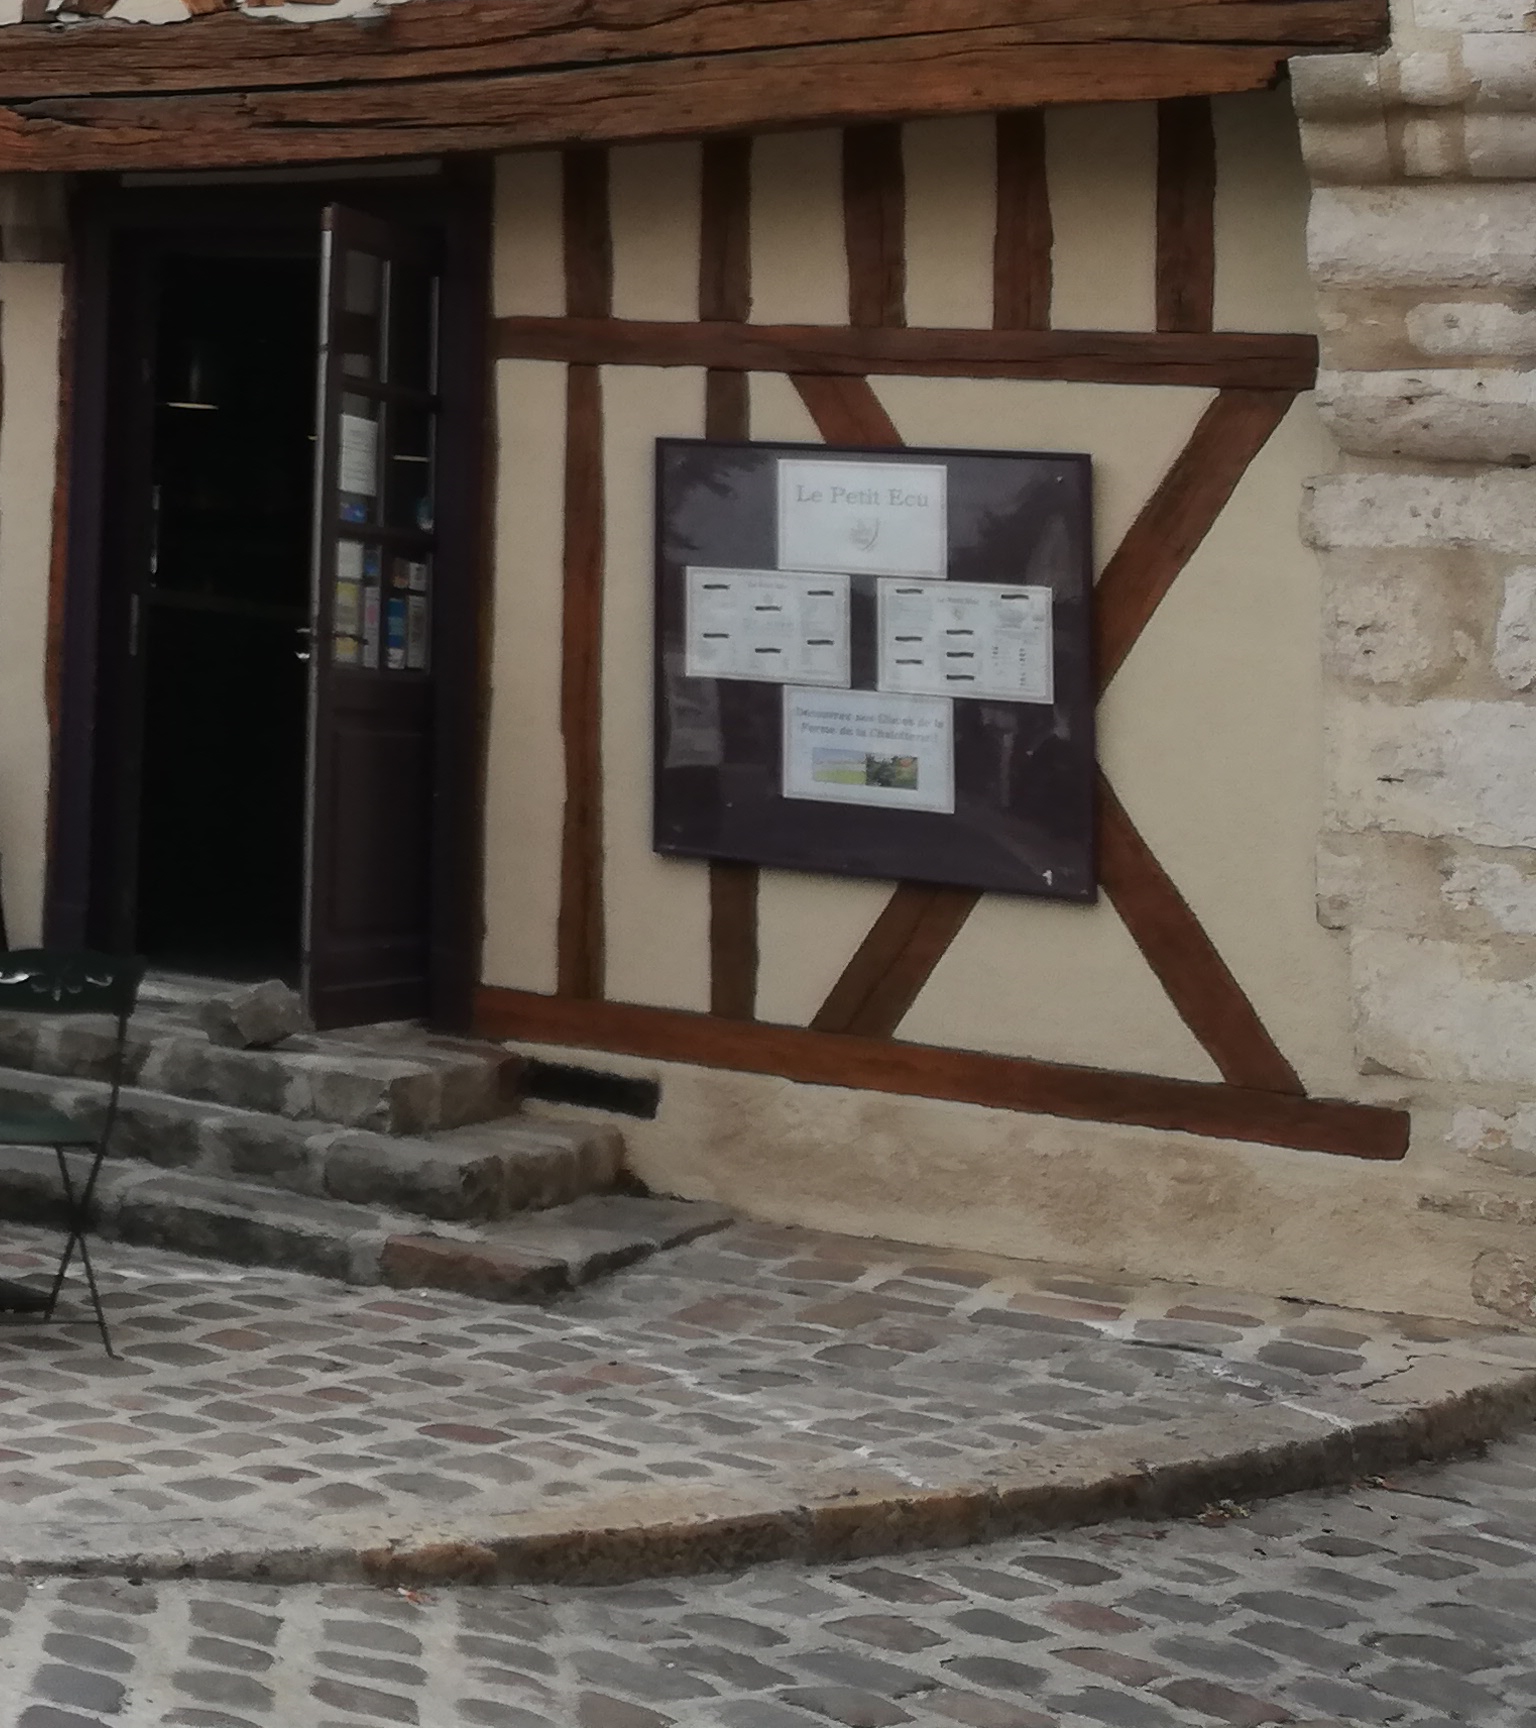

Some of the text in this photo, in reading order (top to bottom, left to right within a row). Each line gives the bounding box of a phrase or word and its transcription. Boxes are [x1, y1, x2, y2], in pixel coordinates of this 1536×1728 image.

[796, 484, 929, 508] Le Petit Ecu
